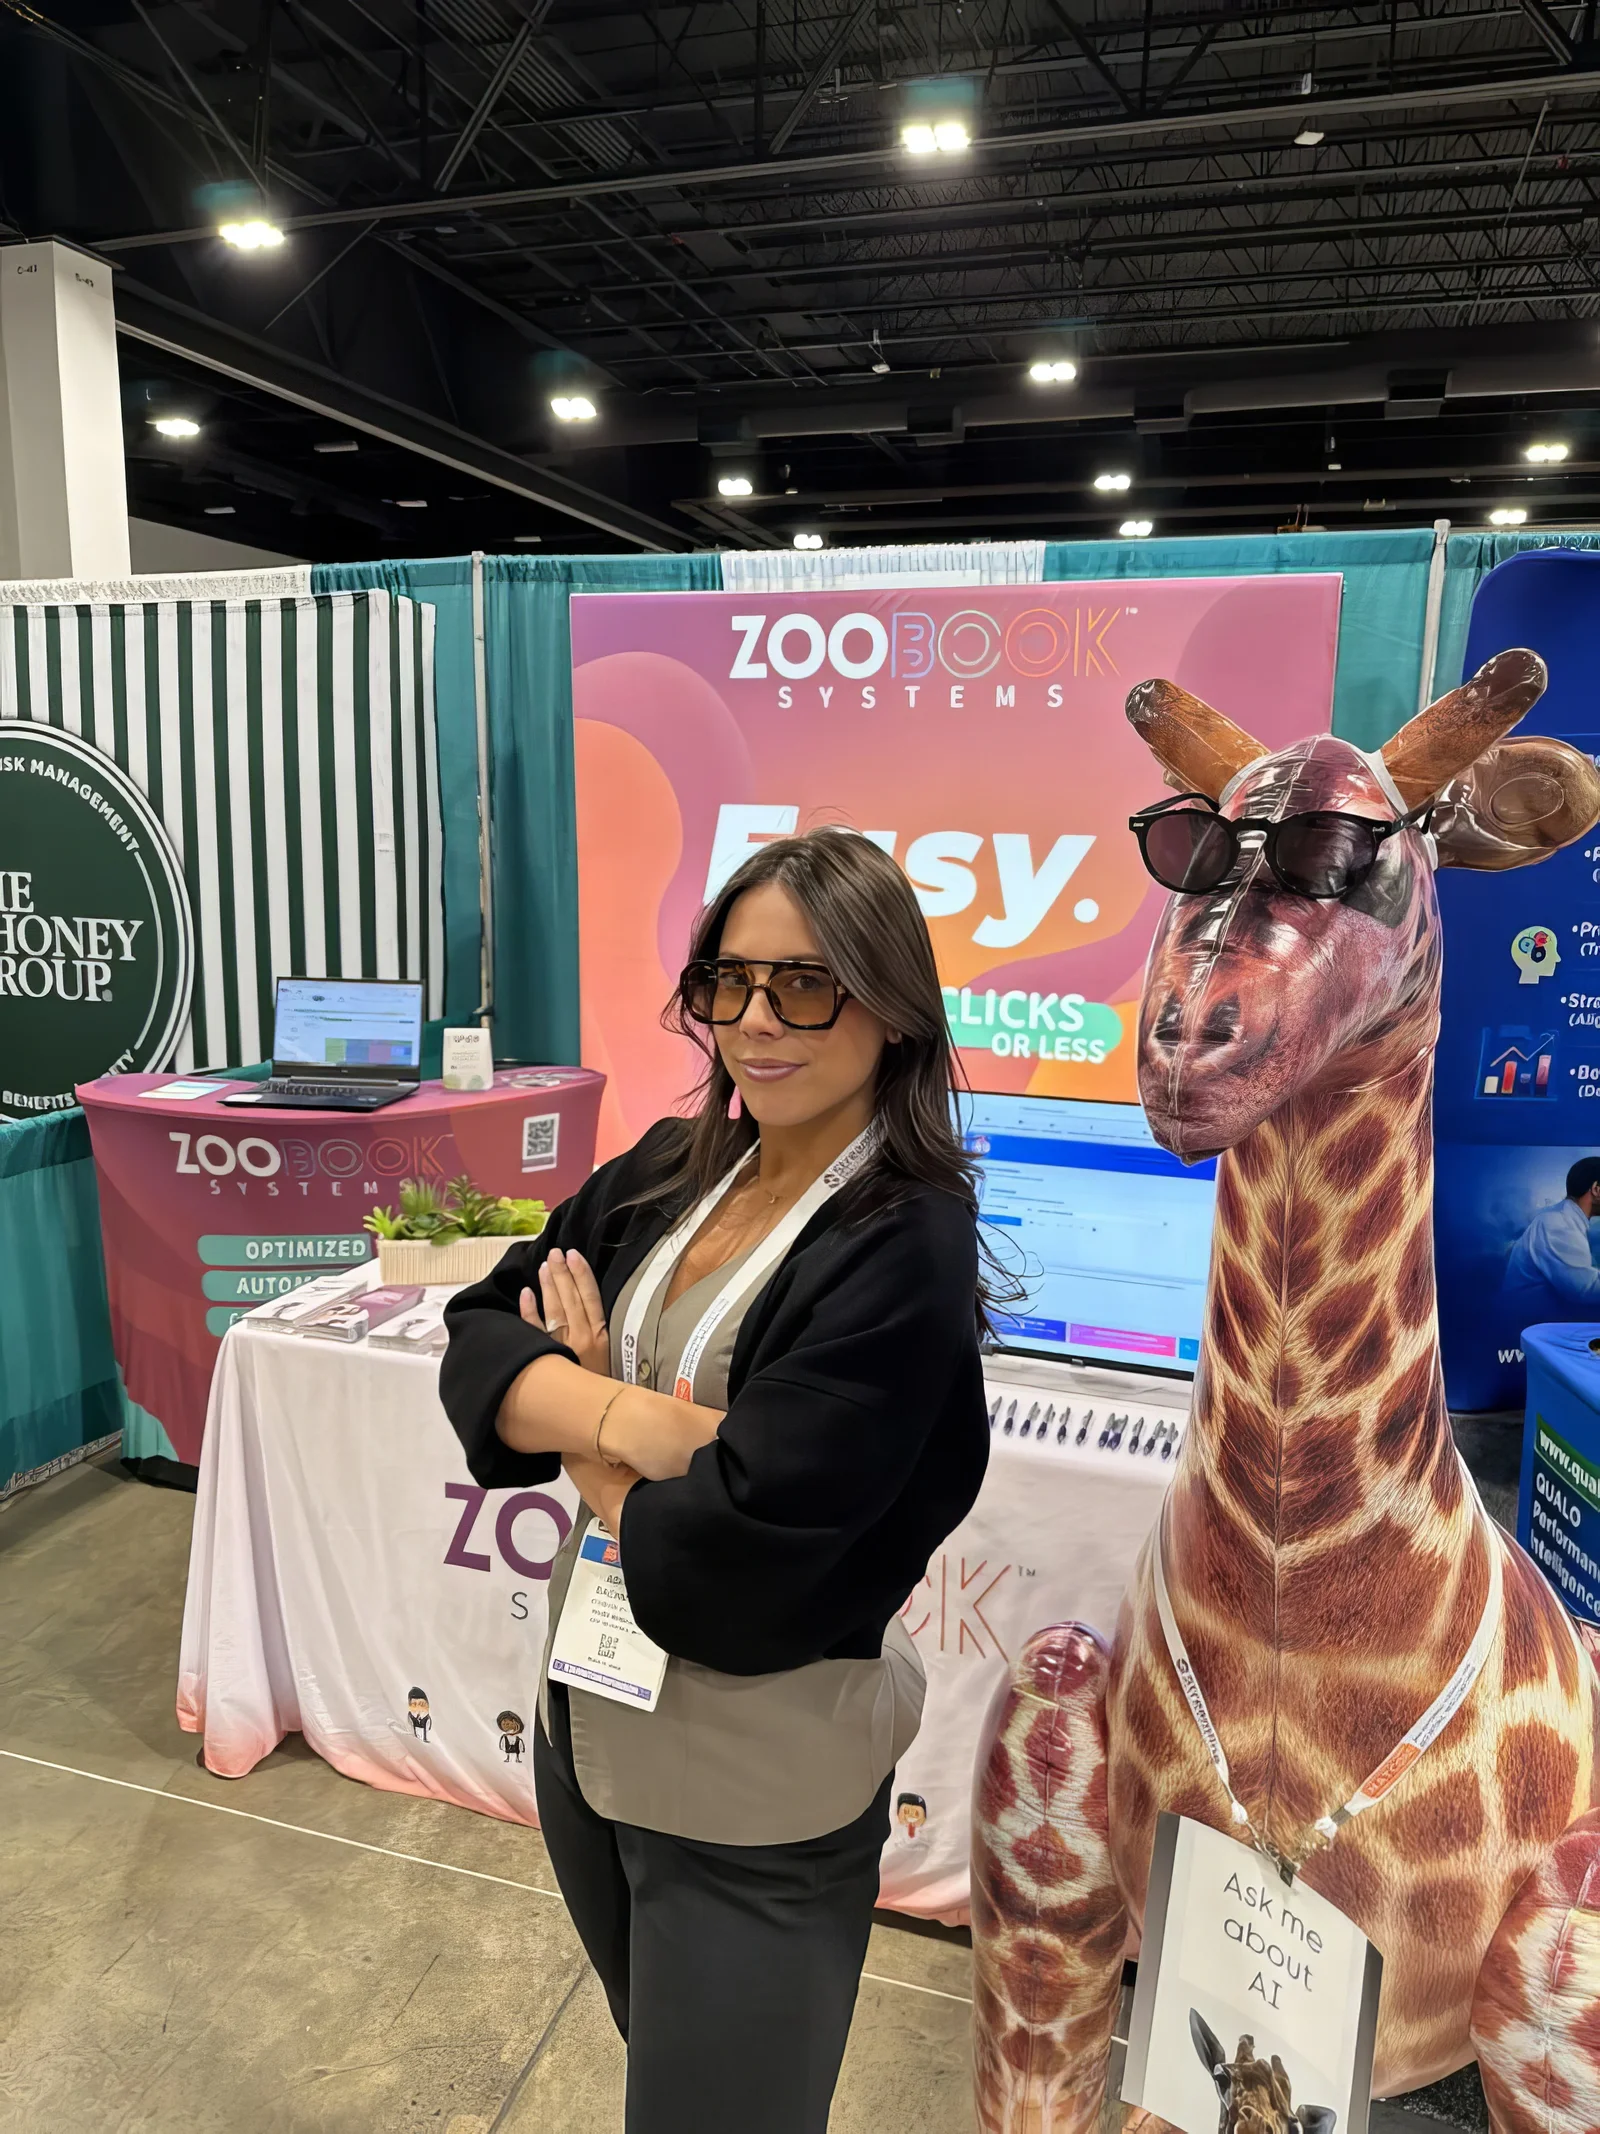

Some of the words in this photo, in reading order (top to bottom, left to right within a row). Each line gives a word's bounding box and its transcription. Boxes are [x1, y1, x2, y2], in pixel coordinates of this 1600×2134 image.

[729, 608, 1122, 680] ZOOBOOK
[777, 684, 1064, 709] SYSTEMS
[30, 758, 140, 851] MANAGEMENT
[702, 803, 1099, 949] Esy.
[991, 1031, 1031, 1059] OR
[1038, 1034, 1106, 1064] LESS
[3, 1090, 75, 1110] BENEFITS
[169, 1131, 447, 1178] ZOOBOOK
[245, 1240, 366, 1260] OPTIMIZED
[1536, 1472, 1581, 1528] QUALO
[1223, 1872, 1273, 1920] Ask
[1281, 1908, 1323, 1954] me
[1223, 1918, 1313, 1993] about
[1247, 1971, 1283, 2010] AI
